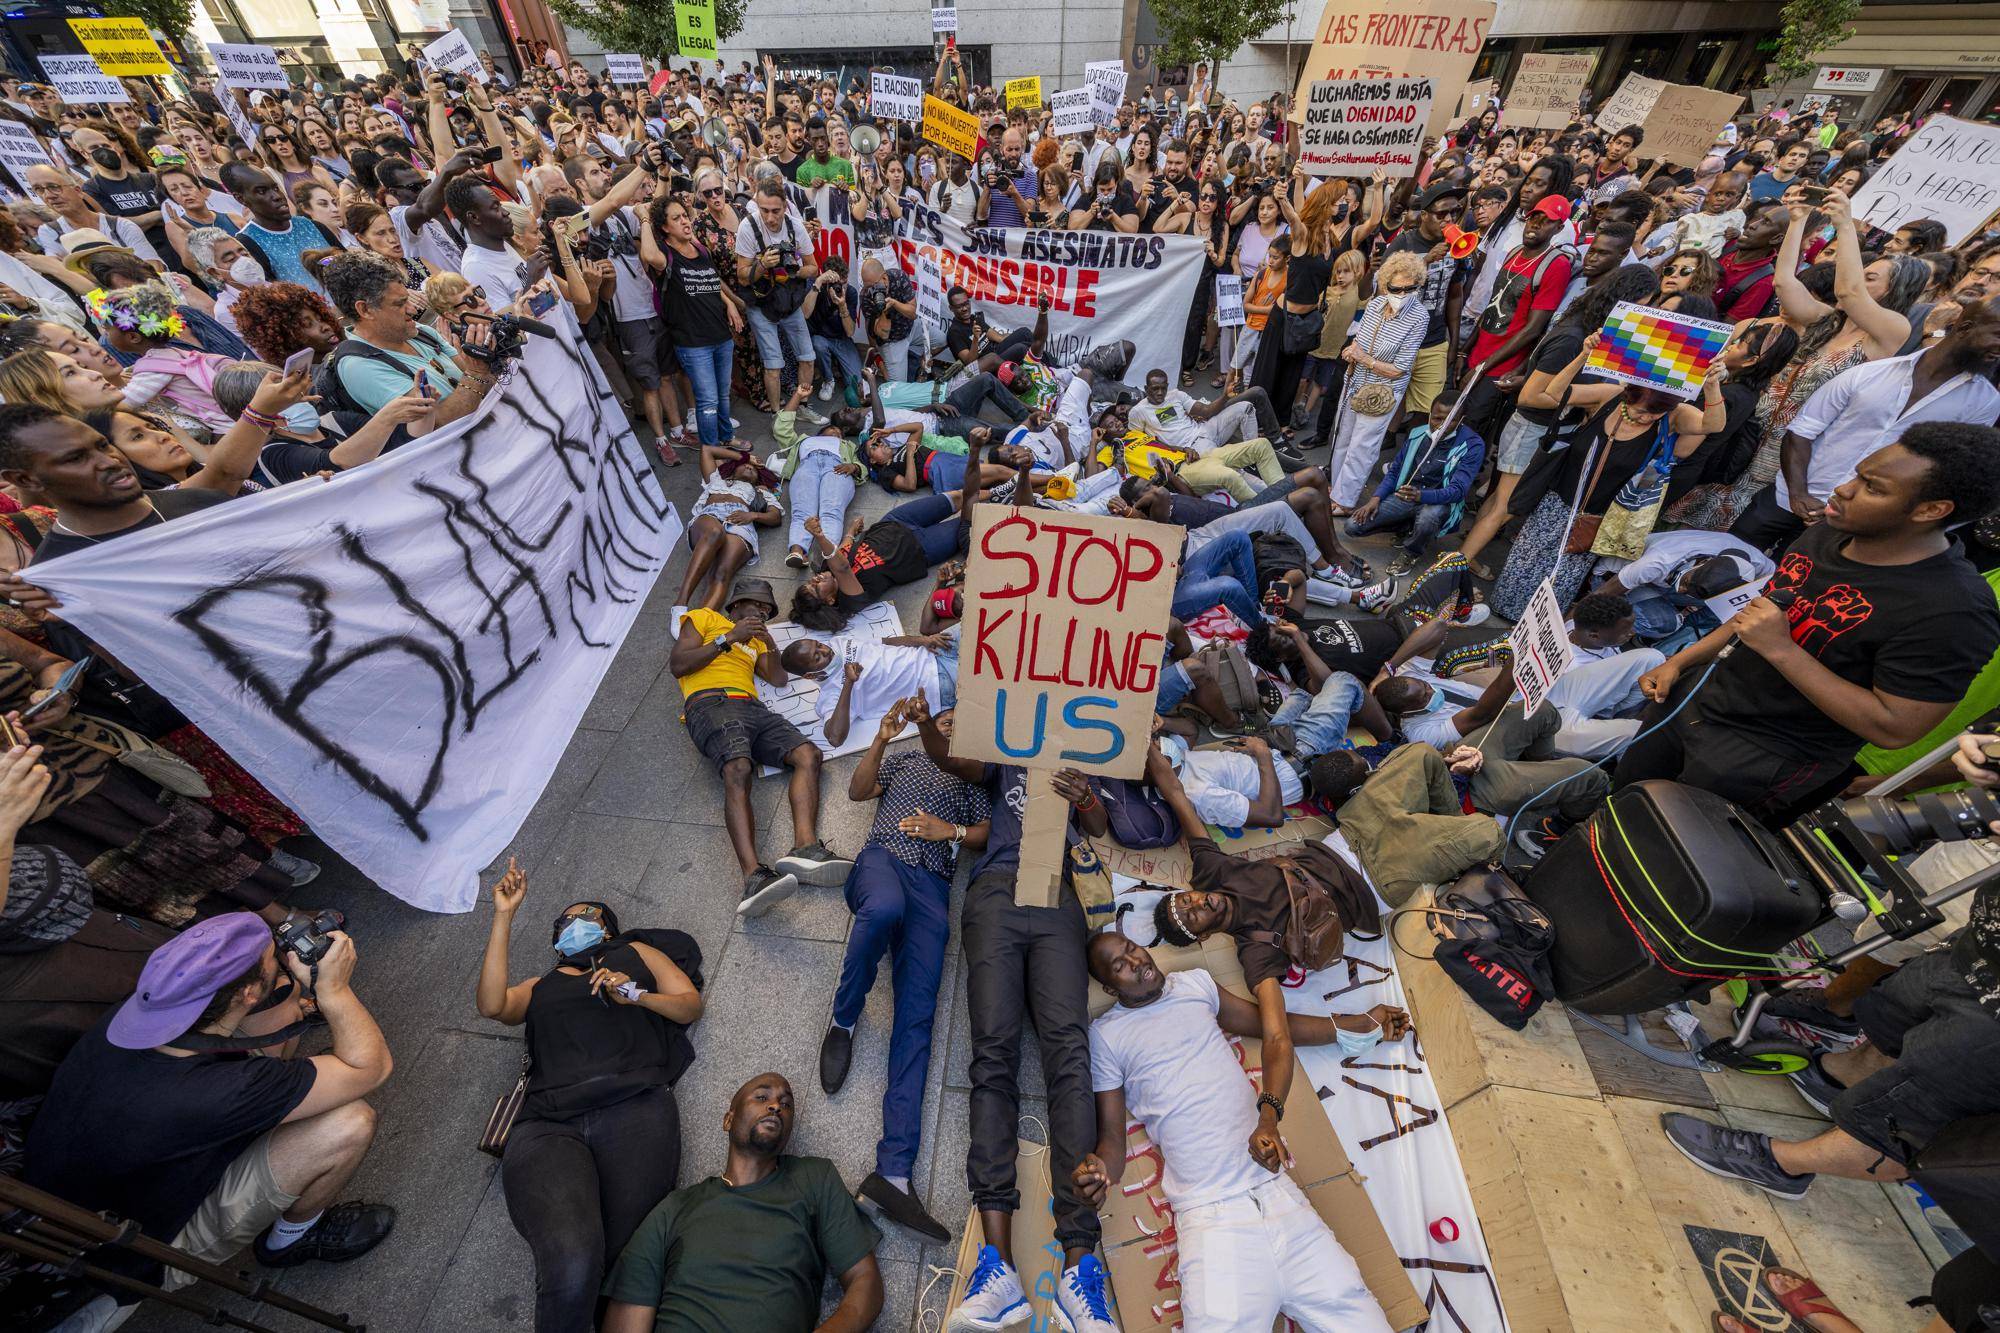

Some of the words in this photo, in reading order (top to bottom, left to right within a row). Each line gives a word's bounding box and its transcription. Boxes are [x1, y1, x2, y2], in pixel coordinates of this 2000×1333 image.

[688, 16, 702, 28] ES
[1323, 14, 1359, 45] LAS
[1362, 14, 1487, 54] FRONTERAS
[680, 36, 715, 50] ILEGAL
[232, 52, 253, 64] roba
[253, 53, 261, 64] al
[260, 53, 277, 65] Sur
[222, 67, 250, 80] bienes
[249, 71, 257, 83] y
[873, 77, 883, 93] EL
[885, 79, 920, 98] RACISMO
[1311, 82, 1391, 103] LUCHAREMOS
[1396, 80, 1432, 100] HASTA
[874, 100, 896, 117] IGNORA
[898, 103, 906, 118] AL
[907, 105, 920, 120] SUR
[1307, 108, 1330, 123] QUE
[1331, 108, 1343, 123] LA
[1346, 105, 1416, 123] DIGNIDAD
[950, 113, 978, 139] MUERTOS
[1305, 129, 1321, 145] SE
[1323, 129, 1350, 145] HAGA
[924, 123, 940, 139] POR
[941, 131, 975, 157] PAPELES!
[1878, 163, 1912, 186] NO
[962, 227, 1006, 256] SON
[1021, 230, 1165, 269] ASESINATOS
[980, 512, 1164, 612] STOP
[172, 362, 594, 845] BLACK
[1532, 586, 1544, 611] El
[1513, 618, 1526, 643] El
[974, 606, 1164, 693] KILLING
[995, 688, 1124, 764] US
